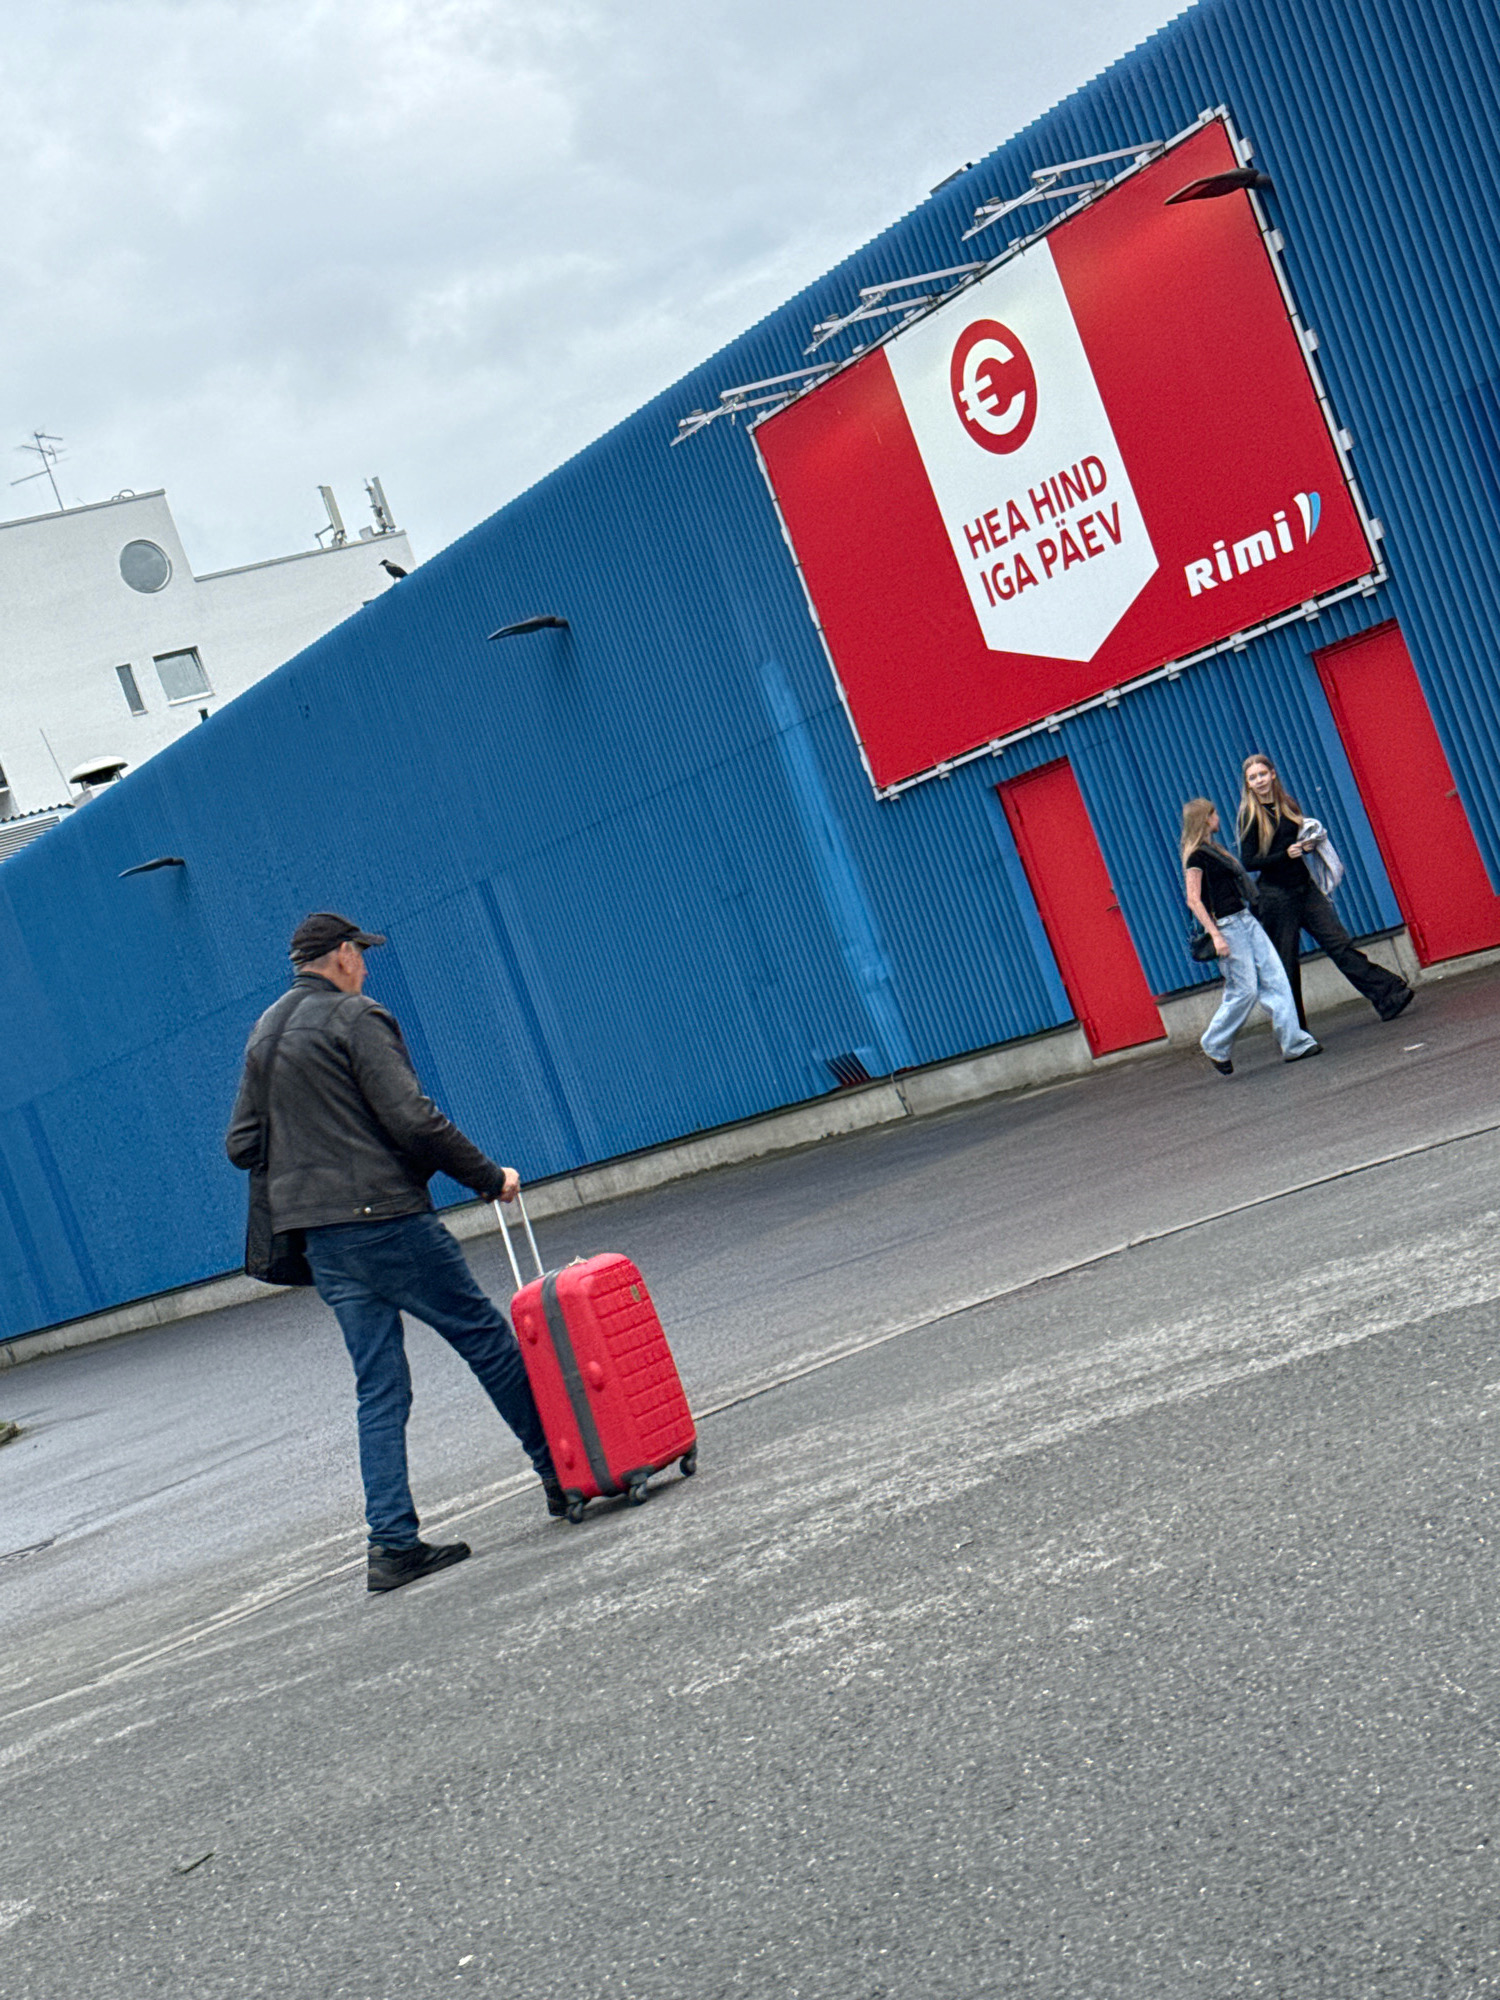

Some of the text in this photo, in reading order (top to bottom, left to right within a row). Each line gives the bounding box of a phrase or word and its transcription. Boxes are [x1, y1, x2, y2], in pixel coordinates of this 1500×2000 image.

[963, 455, 1107, 559] HEA HIND
[980, 502, 1123, 607] IGA PÄEV
